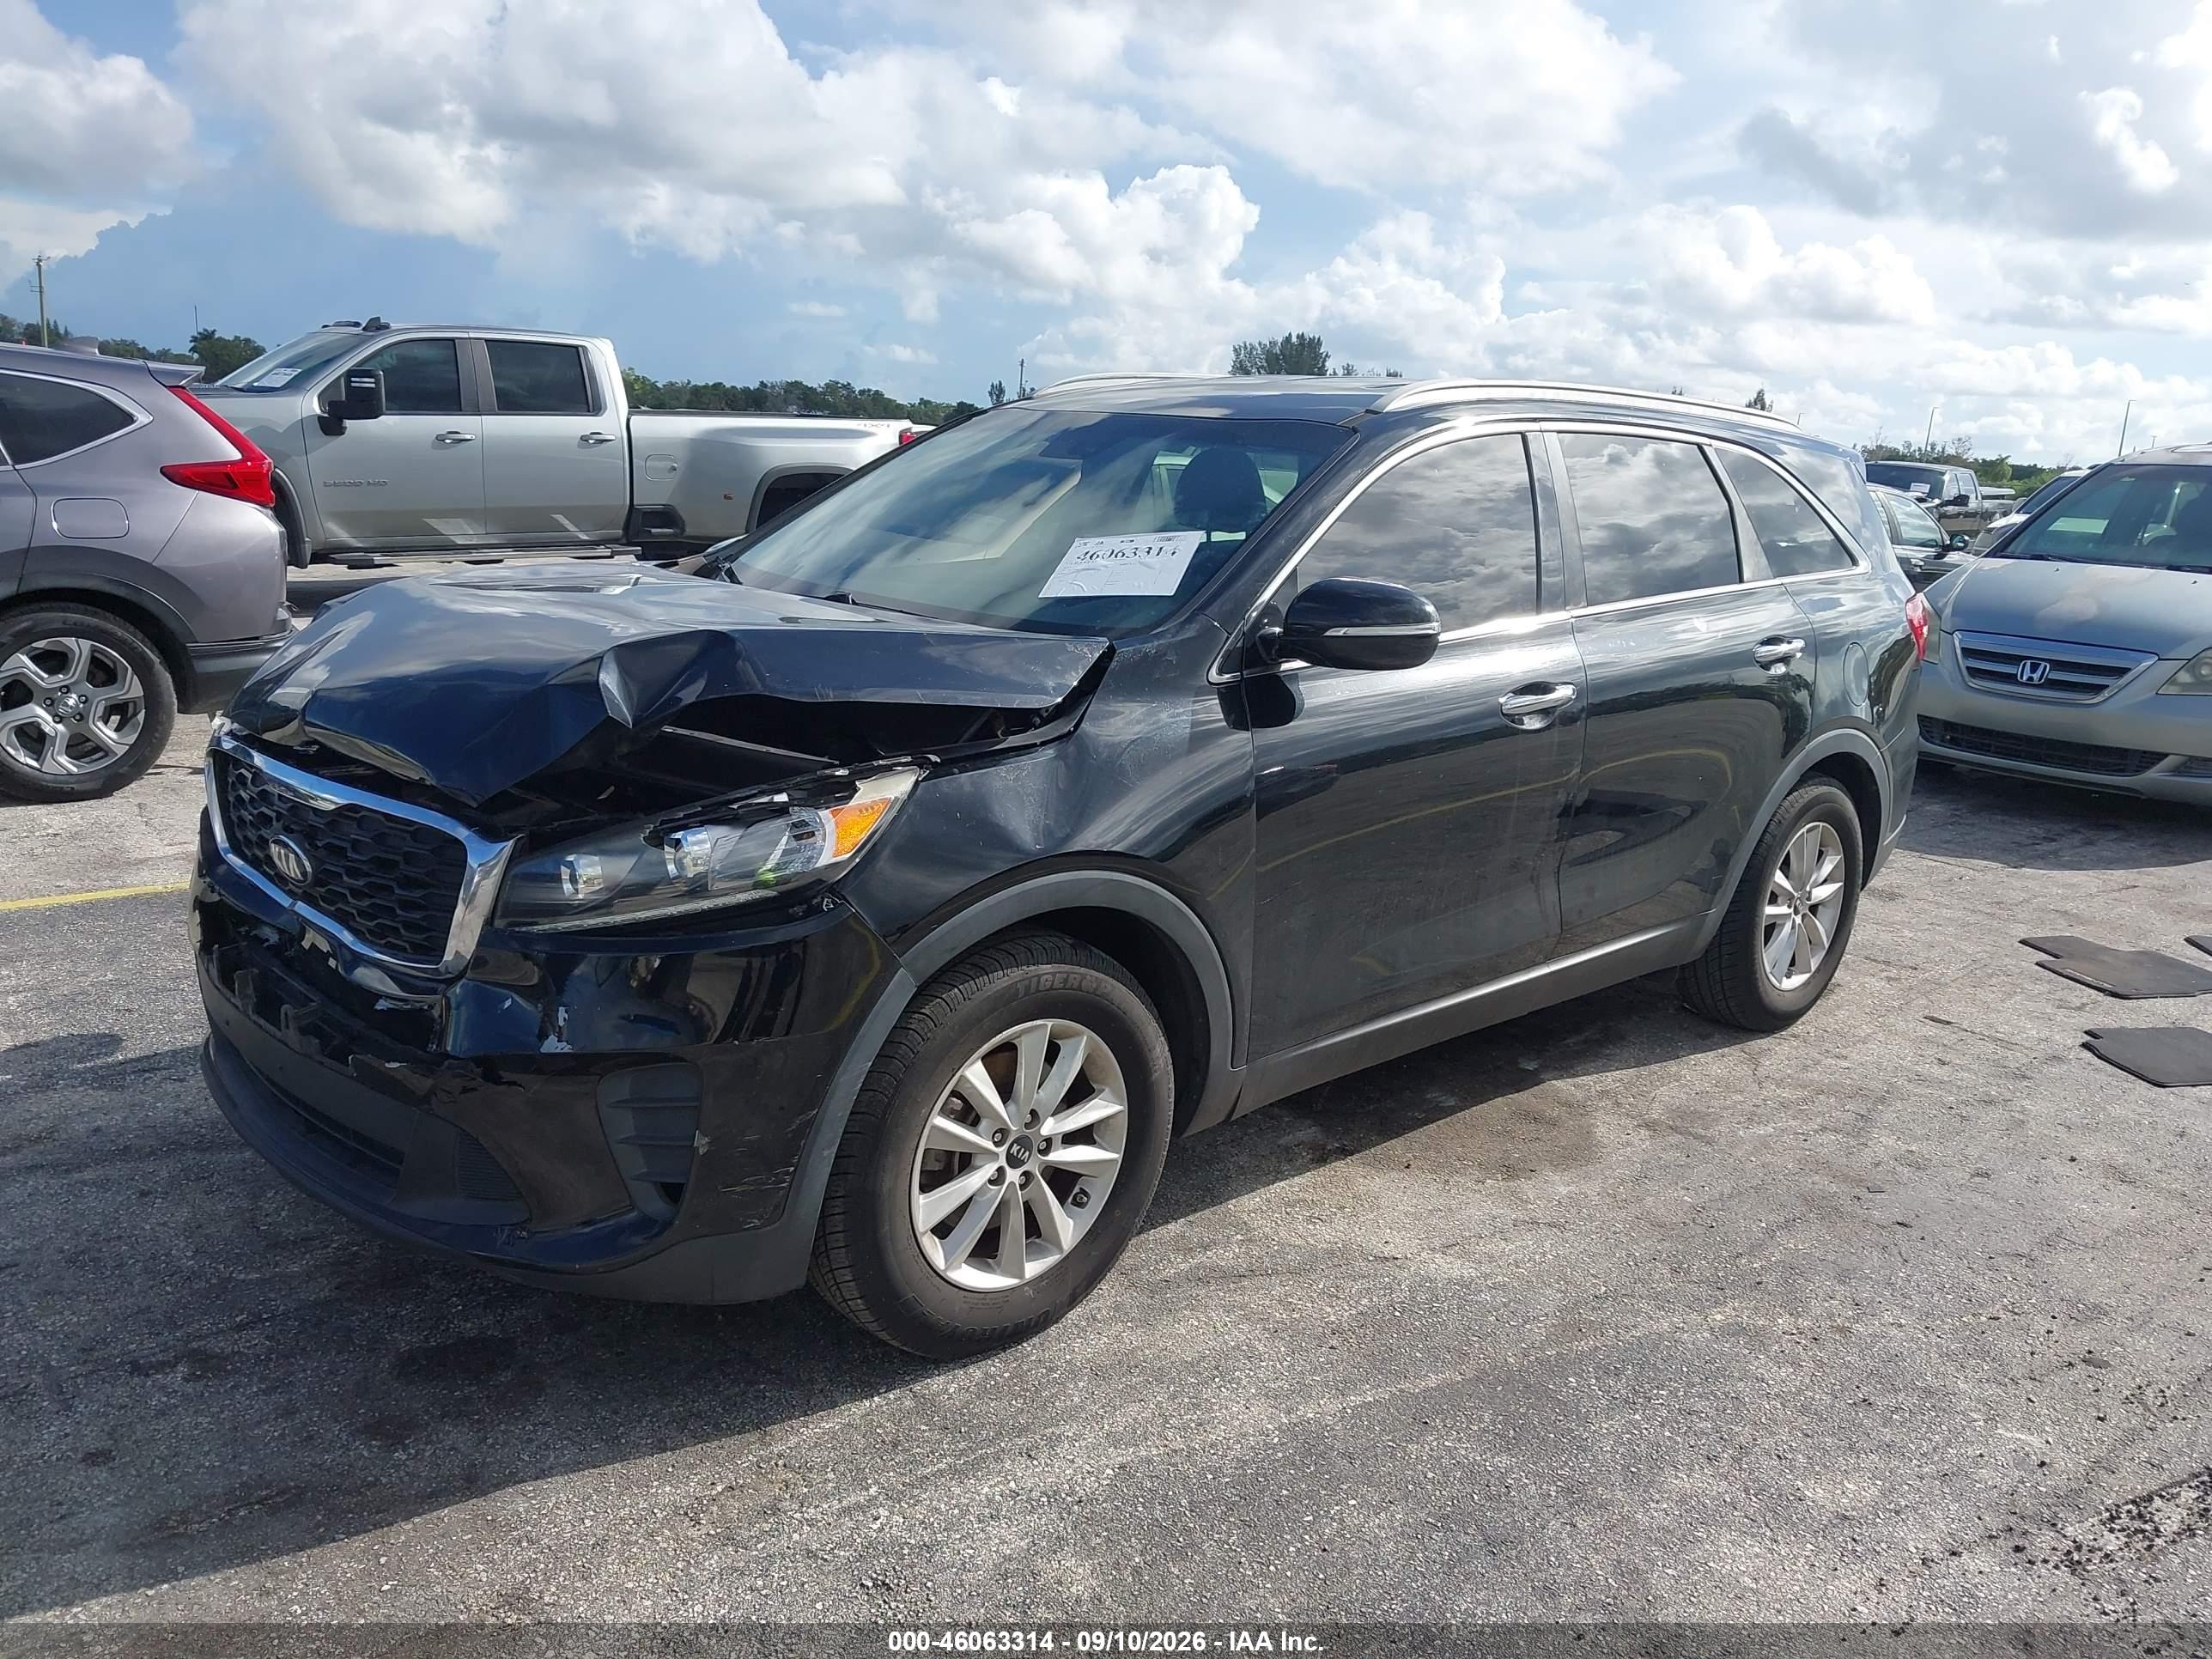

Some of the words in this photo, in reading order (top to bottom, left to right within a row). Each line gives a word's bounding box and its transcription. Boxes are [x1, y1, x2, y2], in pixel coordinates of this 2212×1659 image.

[1076, 545, 1182, 561] 46063314
[270, 842, 304, 881] KIA
[1017, 972, 1082, 1000] TIGER
[1009, 1143, 1030, 1163] KIA
